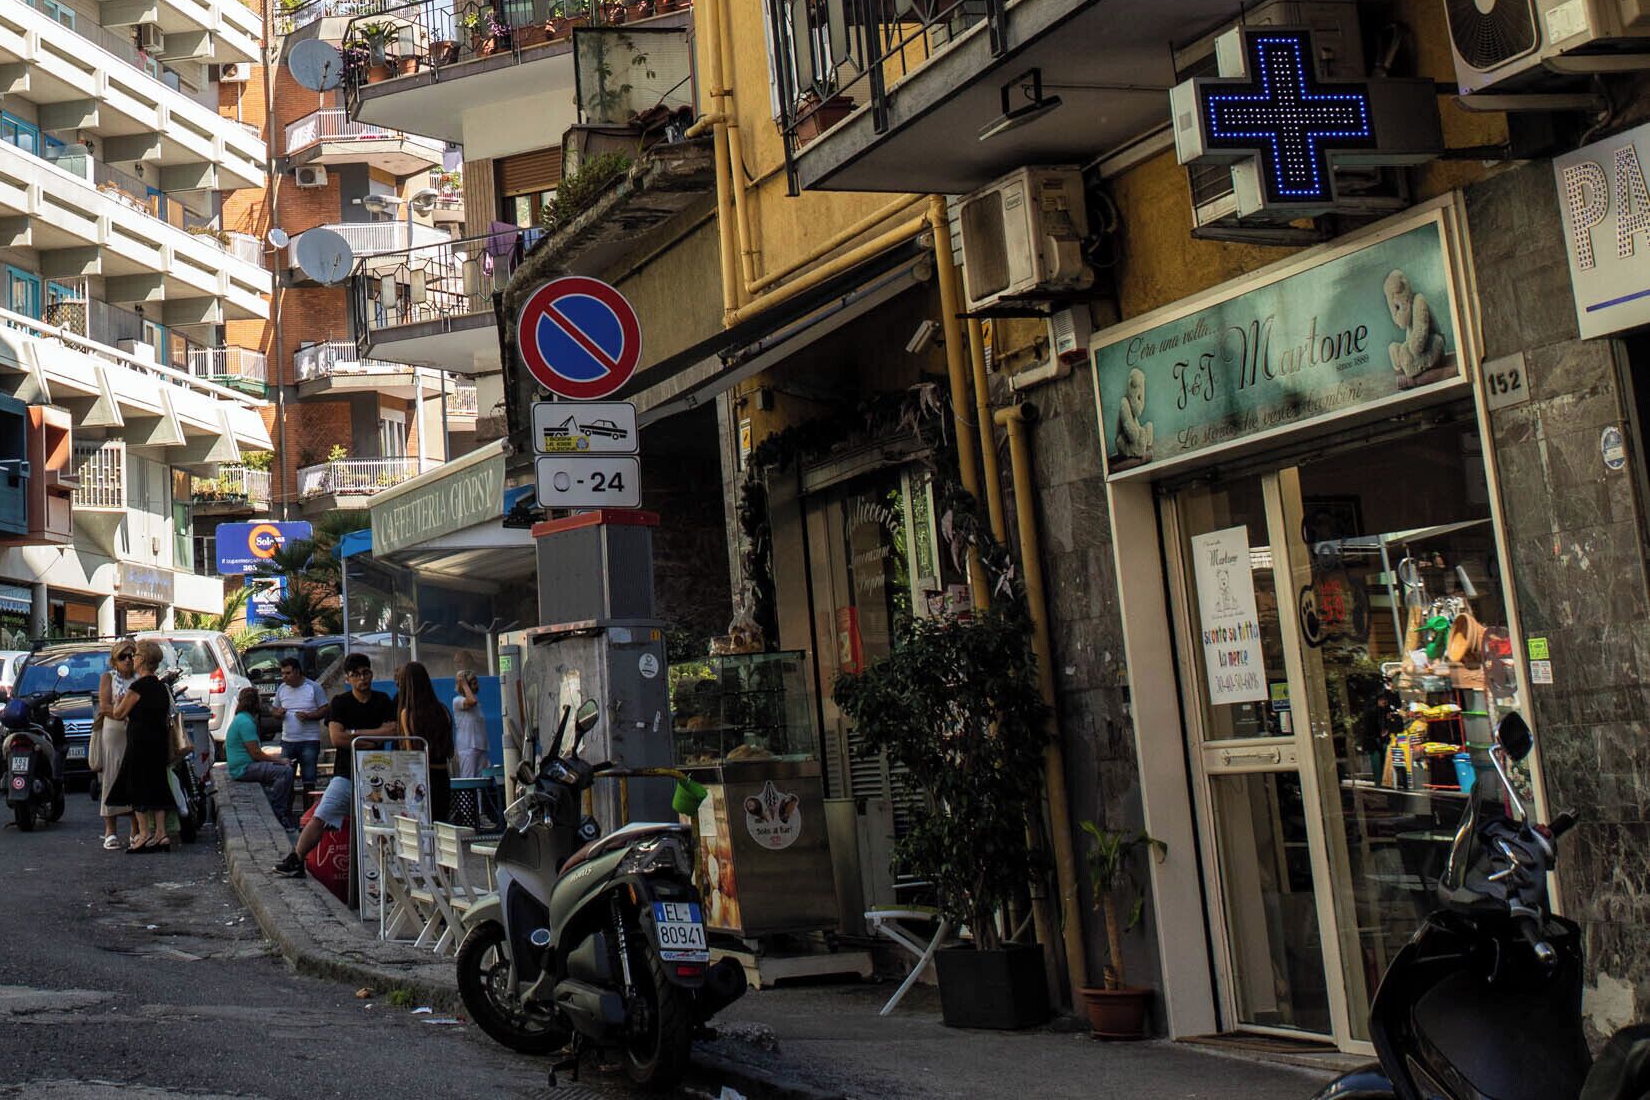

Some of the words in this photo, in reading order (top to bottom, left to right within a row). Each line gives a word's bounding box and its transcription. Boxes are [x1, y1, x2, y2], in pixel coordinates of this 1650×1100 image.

[1563, 144, 1650, 271] PA
[1159, 334, 1179, 353] una
[1224, 314, 1368, 390] Martone
[1488, 369, 1521, 396] 152
[590, 471, 625, 492] 24
[381, 492, 448, 546] CAFFETTERIA
[1204, 625, 1227, 645] sconto
[1228, 627, 1237, 642] su
[1218, 650, 1227, 667] la
[1228, 650, 1248, 667] merce
[665, 903, 683, 921] EL
[660, 926, 703, 944] 80941
